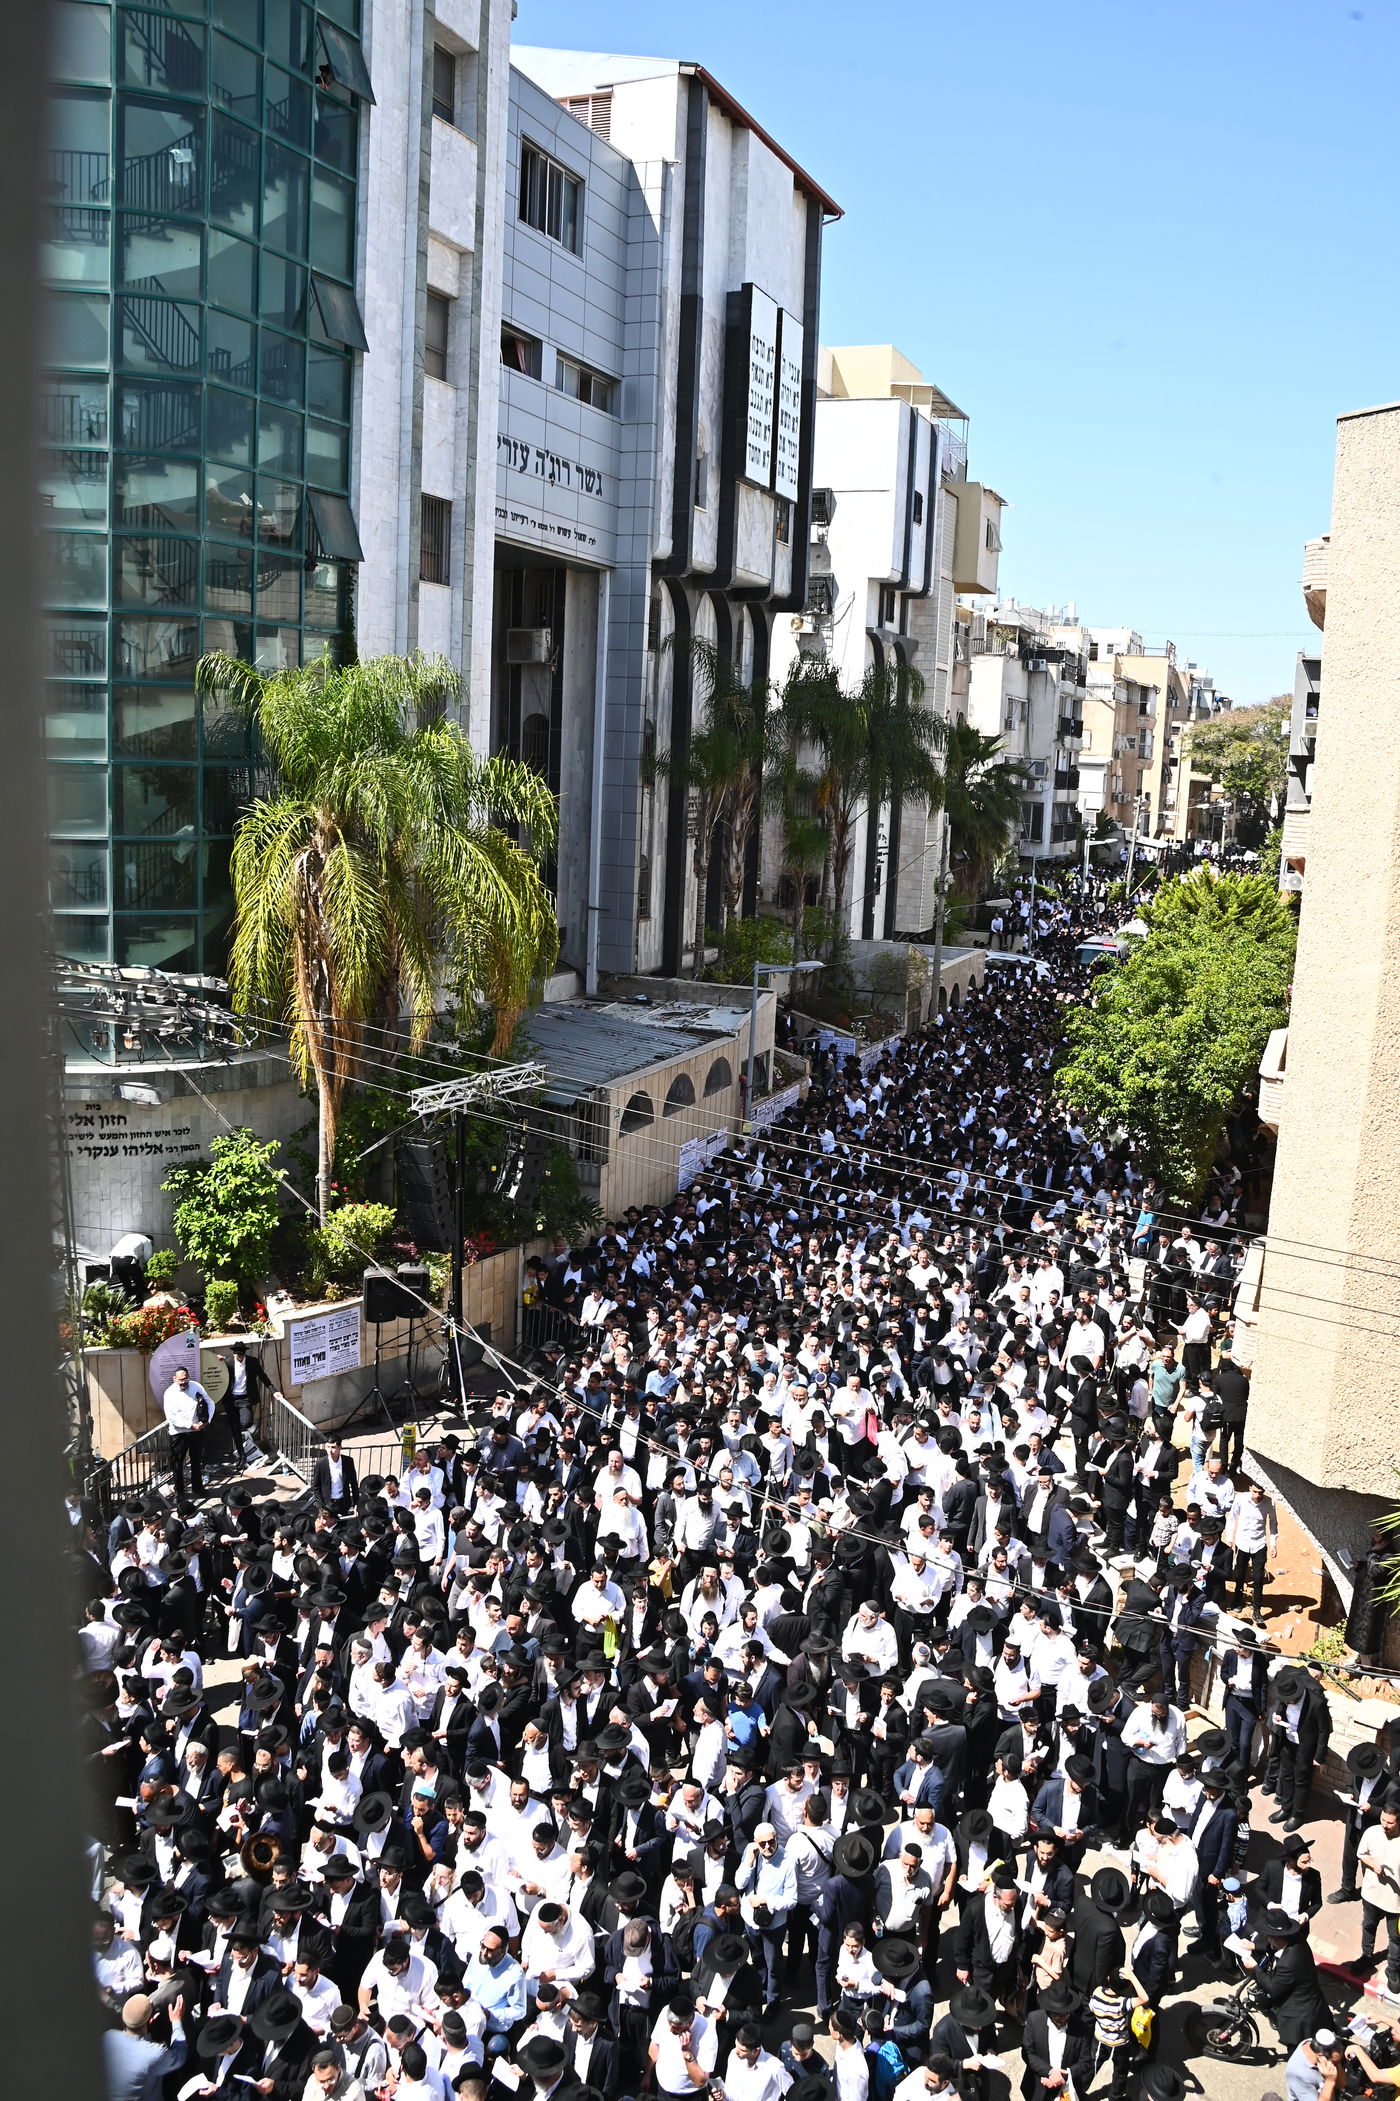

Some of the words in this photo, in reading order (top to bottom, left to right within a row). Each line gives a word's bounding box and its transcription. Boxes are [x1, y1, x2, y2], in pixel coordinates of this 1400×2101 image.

[575, 464, 603, 497] גשר
[85, 1103, 101, 1111] בית
[98, 1114, 127, 1130] חזון
[129, 1131, 152, 1140] החזון
[154, 1129, 171, 1138] איש
[172, 1126, 190, 1136] לזכר
[77, 1145, 119, 1160] ענקרי
[122, 1141, 163, 1156] אליהו
